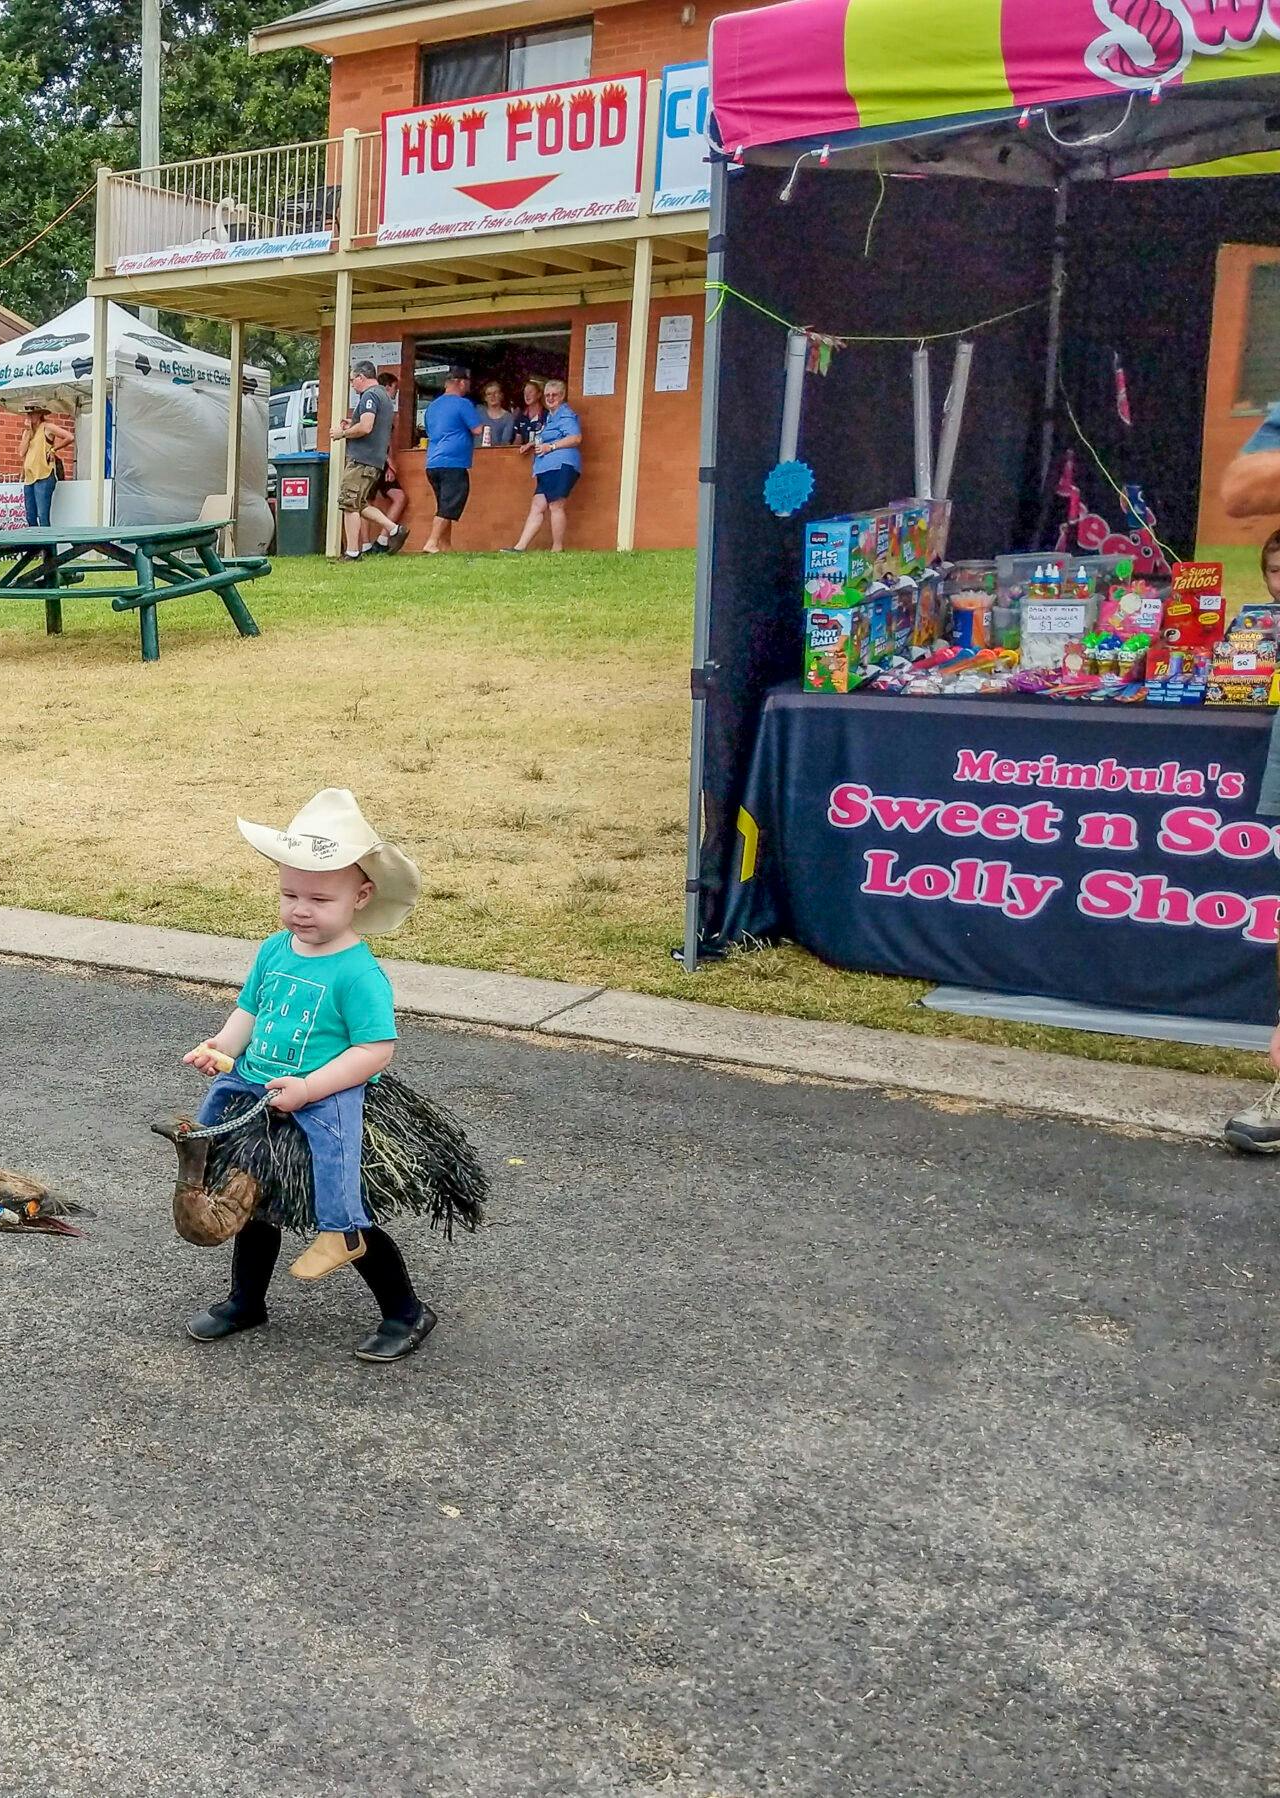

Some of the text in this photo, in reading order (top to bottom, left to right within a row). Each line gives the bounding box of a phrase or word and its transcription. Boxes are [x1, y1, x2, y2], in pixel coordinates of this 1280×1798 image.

[1090, 0, 1280, 84] Sw
[401, 83, 628, 176] HOT FOOD
[655, 193, 690, 209] FRUIT
[378, 227, 425, 242] CALAMARI
[426, 221, 476, 236] SCHNITZEL
[478, 214, 503, 230] FISH
[514, 212, 549, 226] CHIPS
[549, 206, 586, 221] ROAST
[584, 202, 614, 218] BEEF
[616, 199, 636, 214] ROLL
[117, 259, 136, 272] FISH
[167, 253, 193, 266] ROAST
[191, 251, 211, 262] BEEF
[231, 245, 258, 258] FRUIT
[256, 242, 284, 255] DRINK
[287, 239, 302, 251] ICE
[300, 237, 330, 250] CREAM
[14, 367, 24, 378] as
[26, 365, 33, 377] it
[36, 360, 62, 376] Gets!
[159, 359, 170, 374] As
[197, 367, 206, 380] as
[207, 368, 213, 382] it
[366, 399, 373, 409] 6
[810, 557, 838, 569] FARTS
[811, 549, 838, 559] PIG
[1189, 567, 1217, 577] Super
[1173, 575, 1220, 590] Tattoos
[811, 629, 838, 638] SNOT
[811, 636, 839, 647] BALLS
[954, 750, 1244, 798] Merimbula's
[828, 783, 1280, 859] Sweet n So
[861, 849, 1063, 919] Lolly
